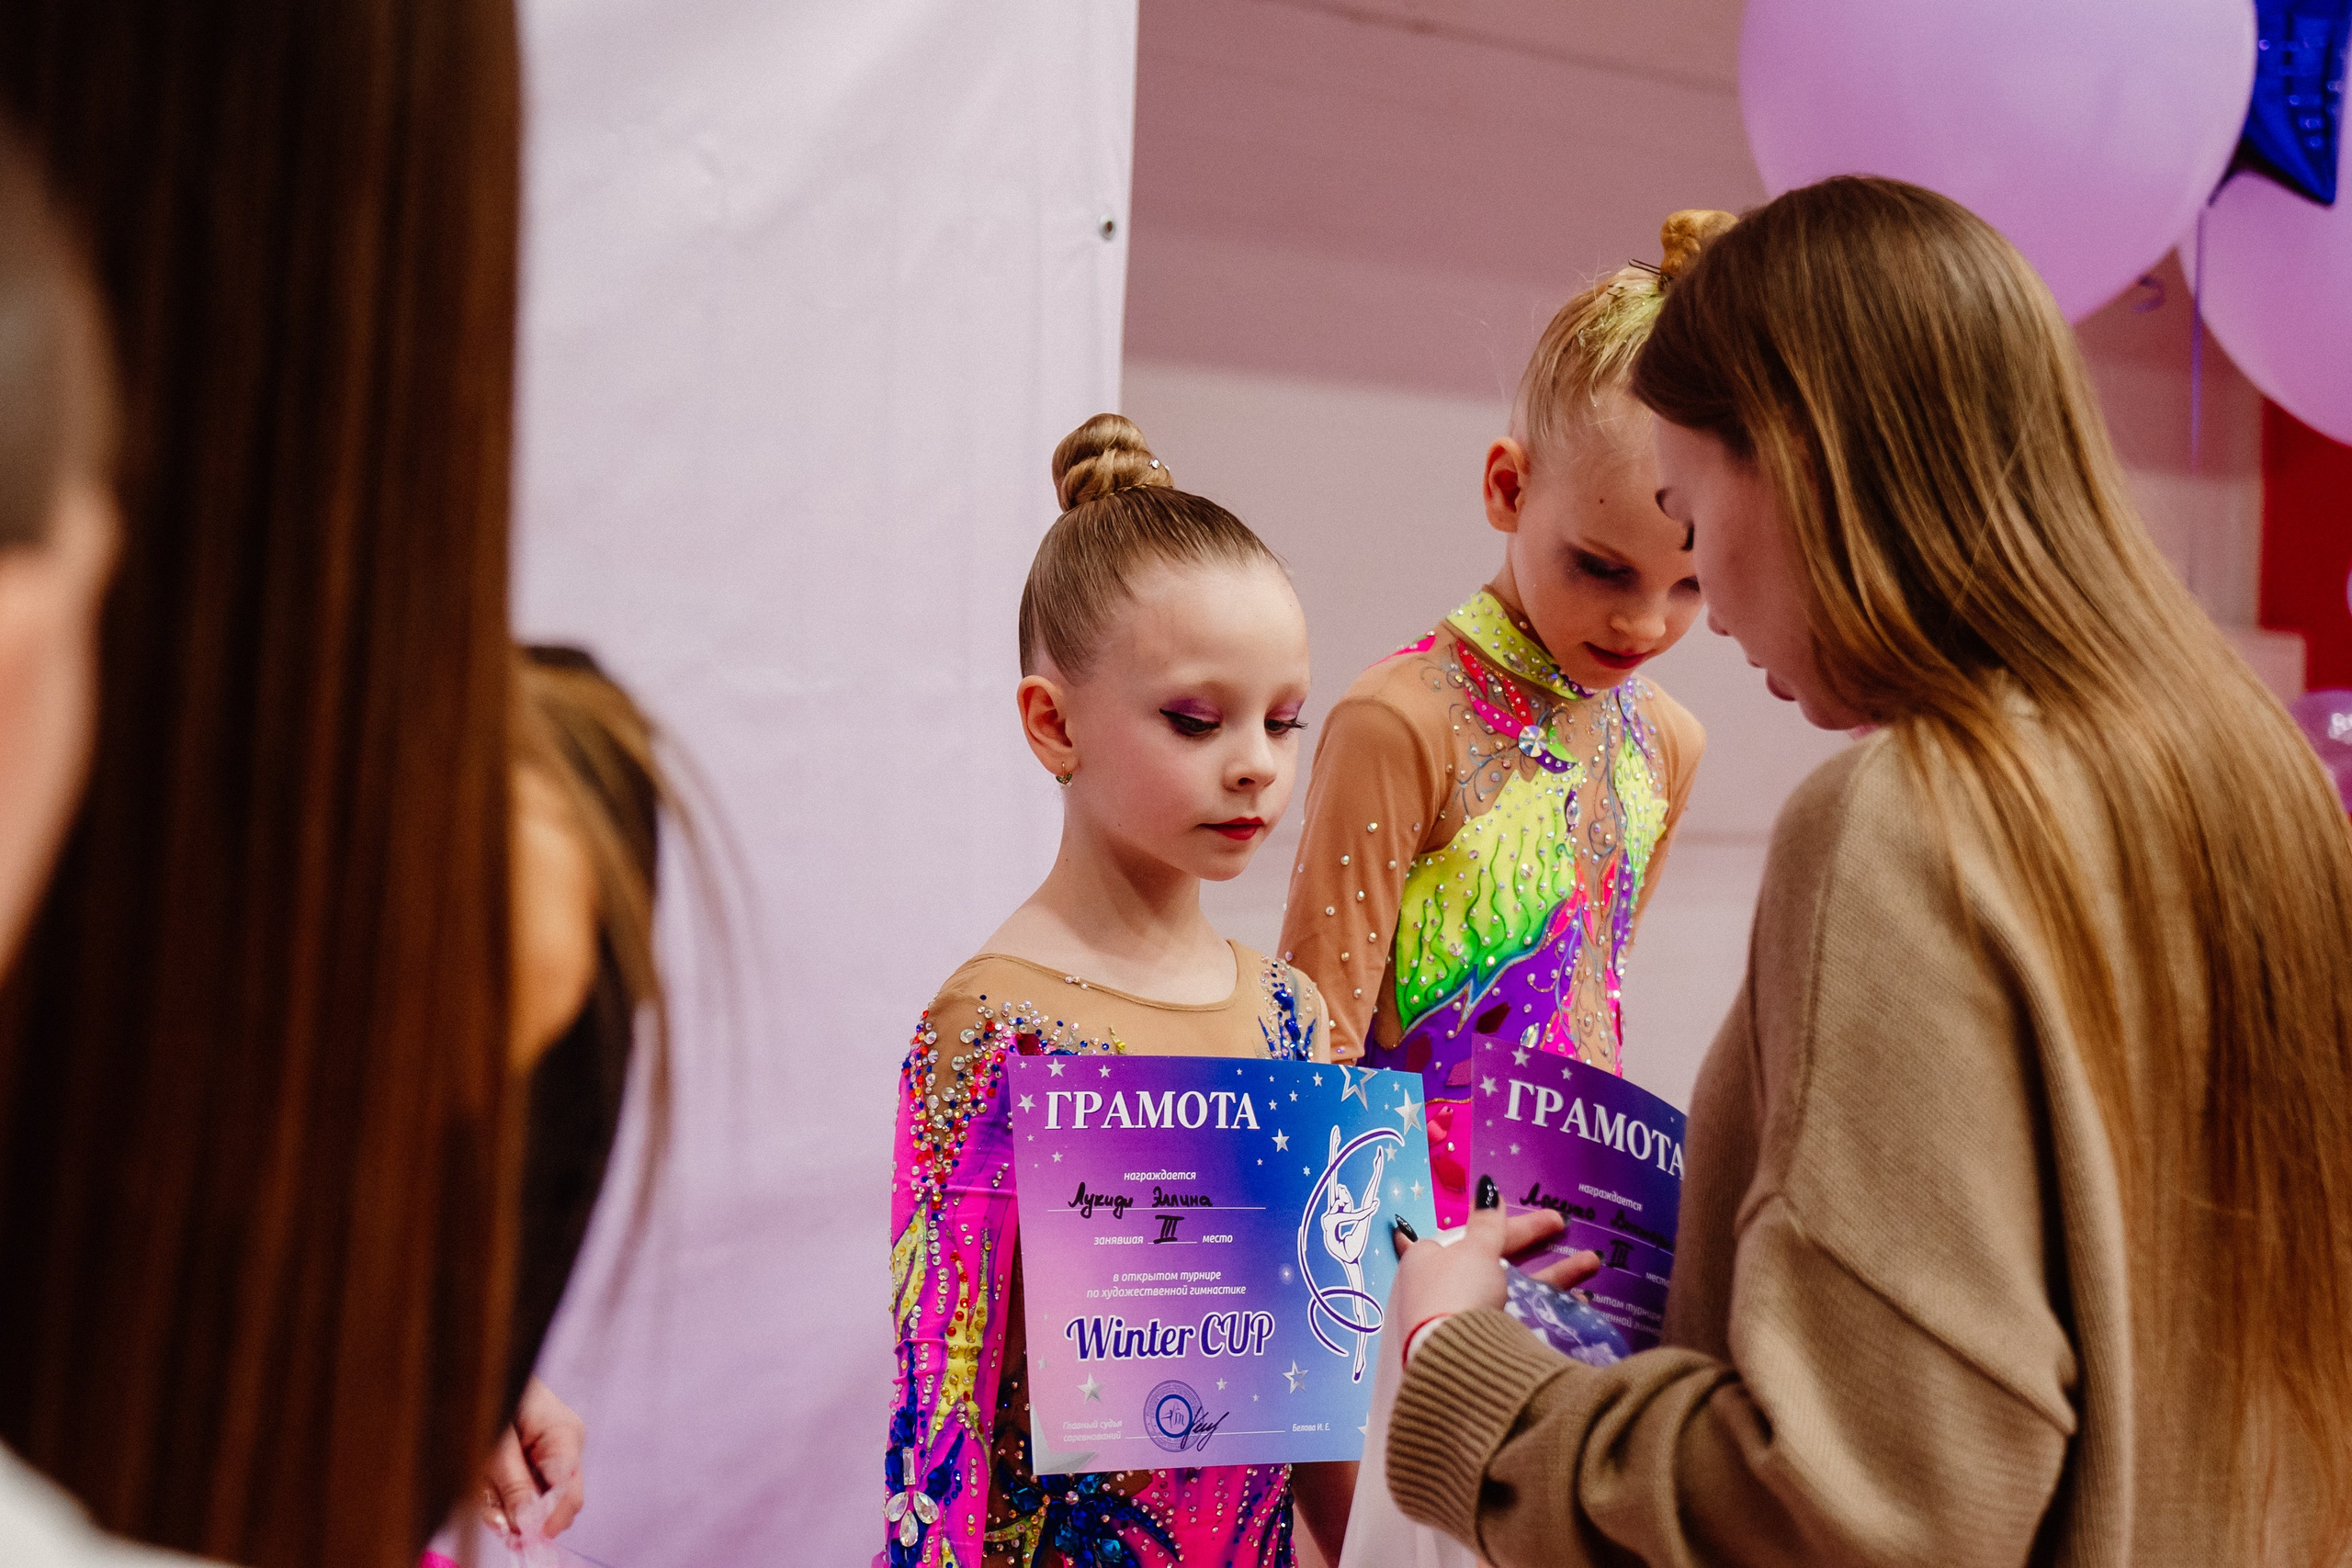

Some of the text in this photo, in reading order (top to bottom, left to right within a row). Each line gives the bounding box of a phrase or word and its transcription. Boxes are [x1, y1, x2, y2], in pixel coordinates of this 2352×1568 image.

[1045, 1090, 1260, 1131] ГРАМОТА
[1504, 1078, 1686, 1181] ГРАМОТА
[1124, 1169, 1197, 1182] награждается
[1577, 1183, 1644, 1213] награждается
[1093, 1235, 1144, 1246] занявшая
[1202, 1234, 1233, 1244] место
[1113, 1271, 1222, 1283] в открытом турнире
[1086, 1285, 1247, 1301] по художественной гимнастике
[1065, 1310, 1276, 1362] Winter CUP
[1063, 1418, 1123, 1429] Главный судья
[1292, 1423, 1317, 1432] Белова
[1063, 1431, 1121, 1442] соревнований
